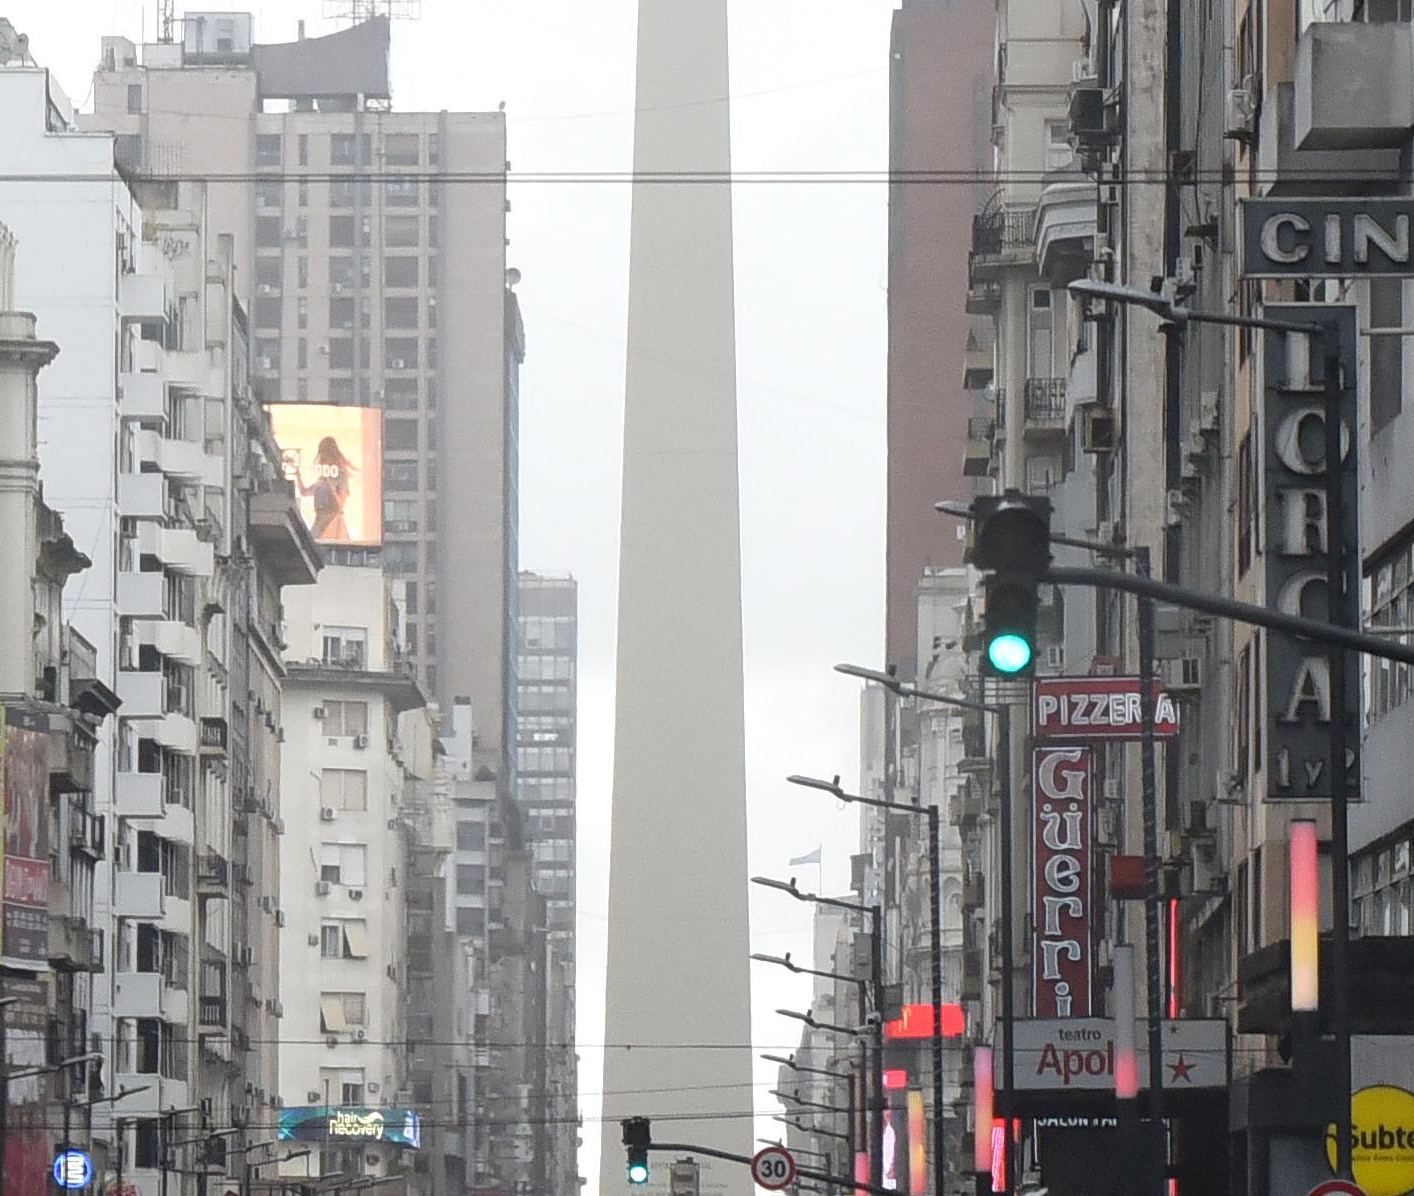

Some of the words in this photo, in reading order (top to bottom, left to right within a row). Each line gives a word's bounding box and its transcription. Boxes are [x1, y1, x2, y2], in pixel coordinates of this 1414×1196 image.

[1038, 692, 1176, 728] PIZZERA
[1058, 1028, 1102, 1041] teatro
[1036, 1040, 1115, 1085] Apol
[336, 1109, 358, 1124] hair
[761, 1159, 786, 1179] 30
